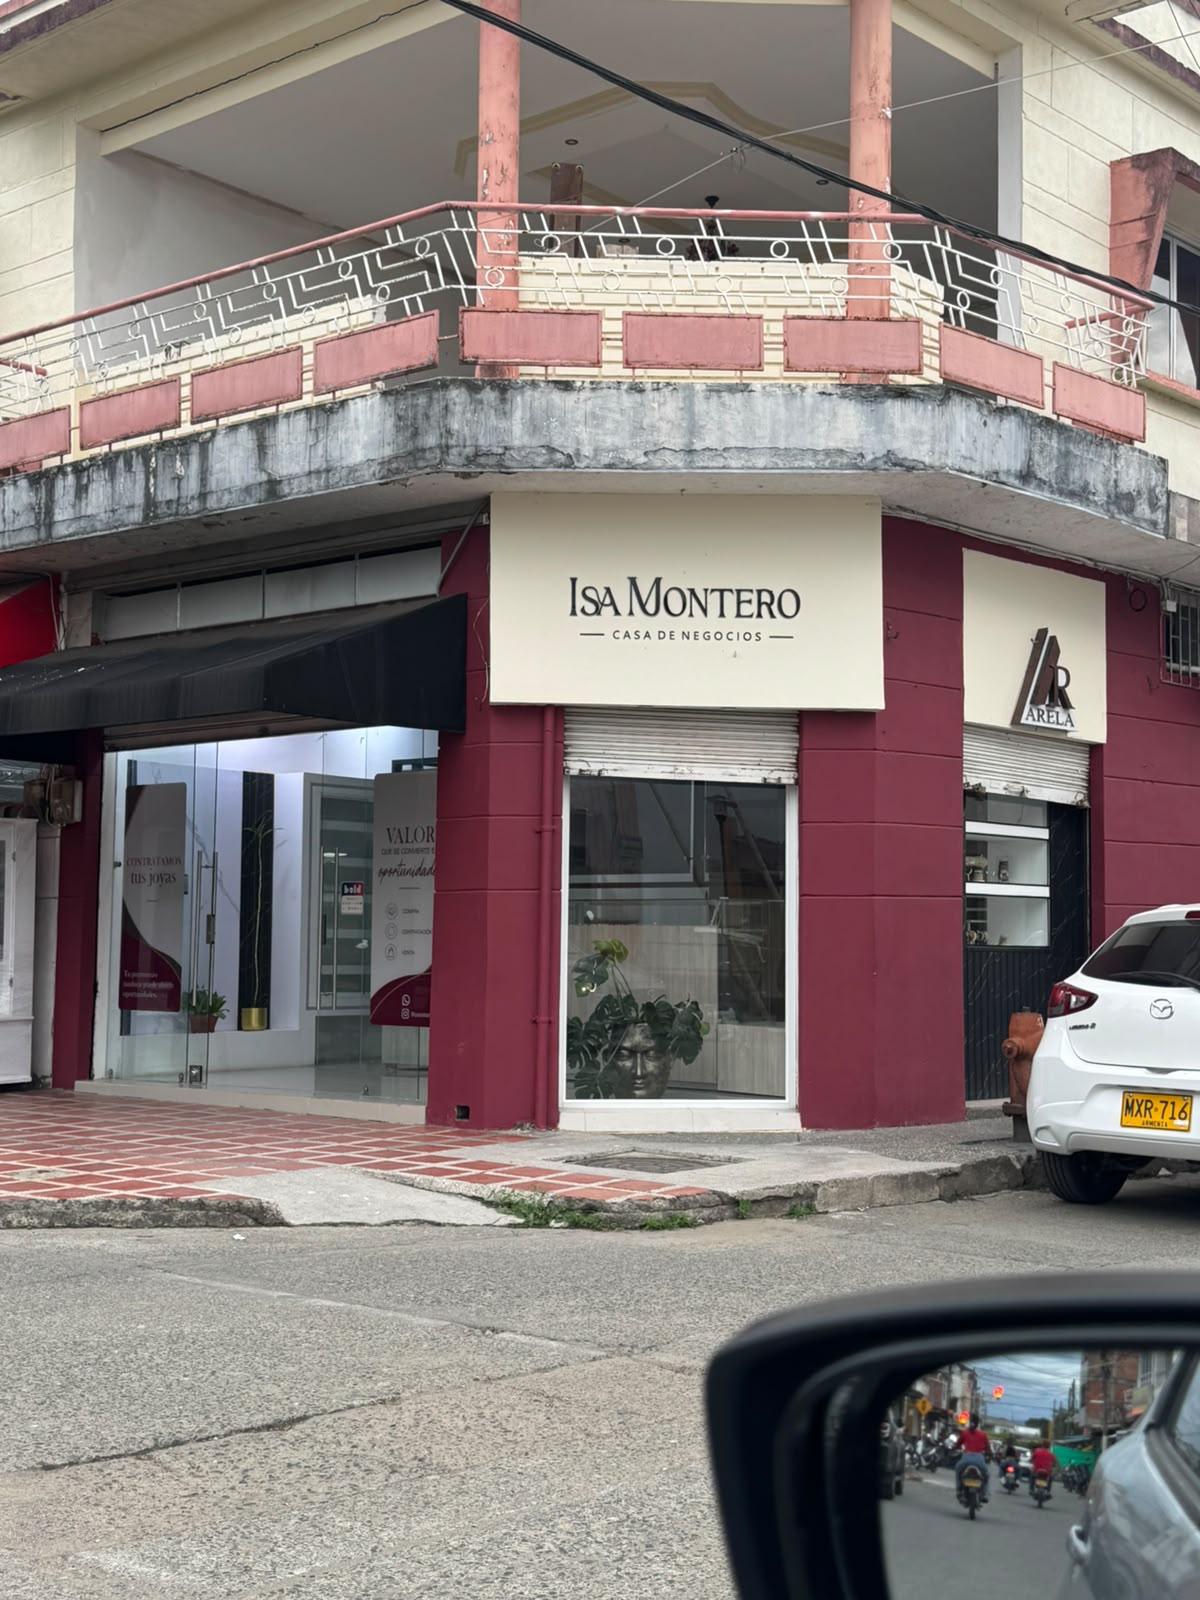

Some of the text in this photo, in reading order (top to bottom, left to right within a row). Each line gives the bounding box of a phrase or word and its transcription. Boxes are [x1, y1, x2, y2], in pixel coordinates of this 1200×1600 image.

[627, 576, 801, 619] MONTERO
[612, 630, 762, 642] CASA DE NEGOCIOS
[1025, 707, 1075, 728] ARELA
[386, 825, 435, 844] VALOR
[131, 868, 177, 888] tus joyas
[343, 884, 362, 894] bold
[1141, 1120, 1168, 1128] ARMENIA
